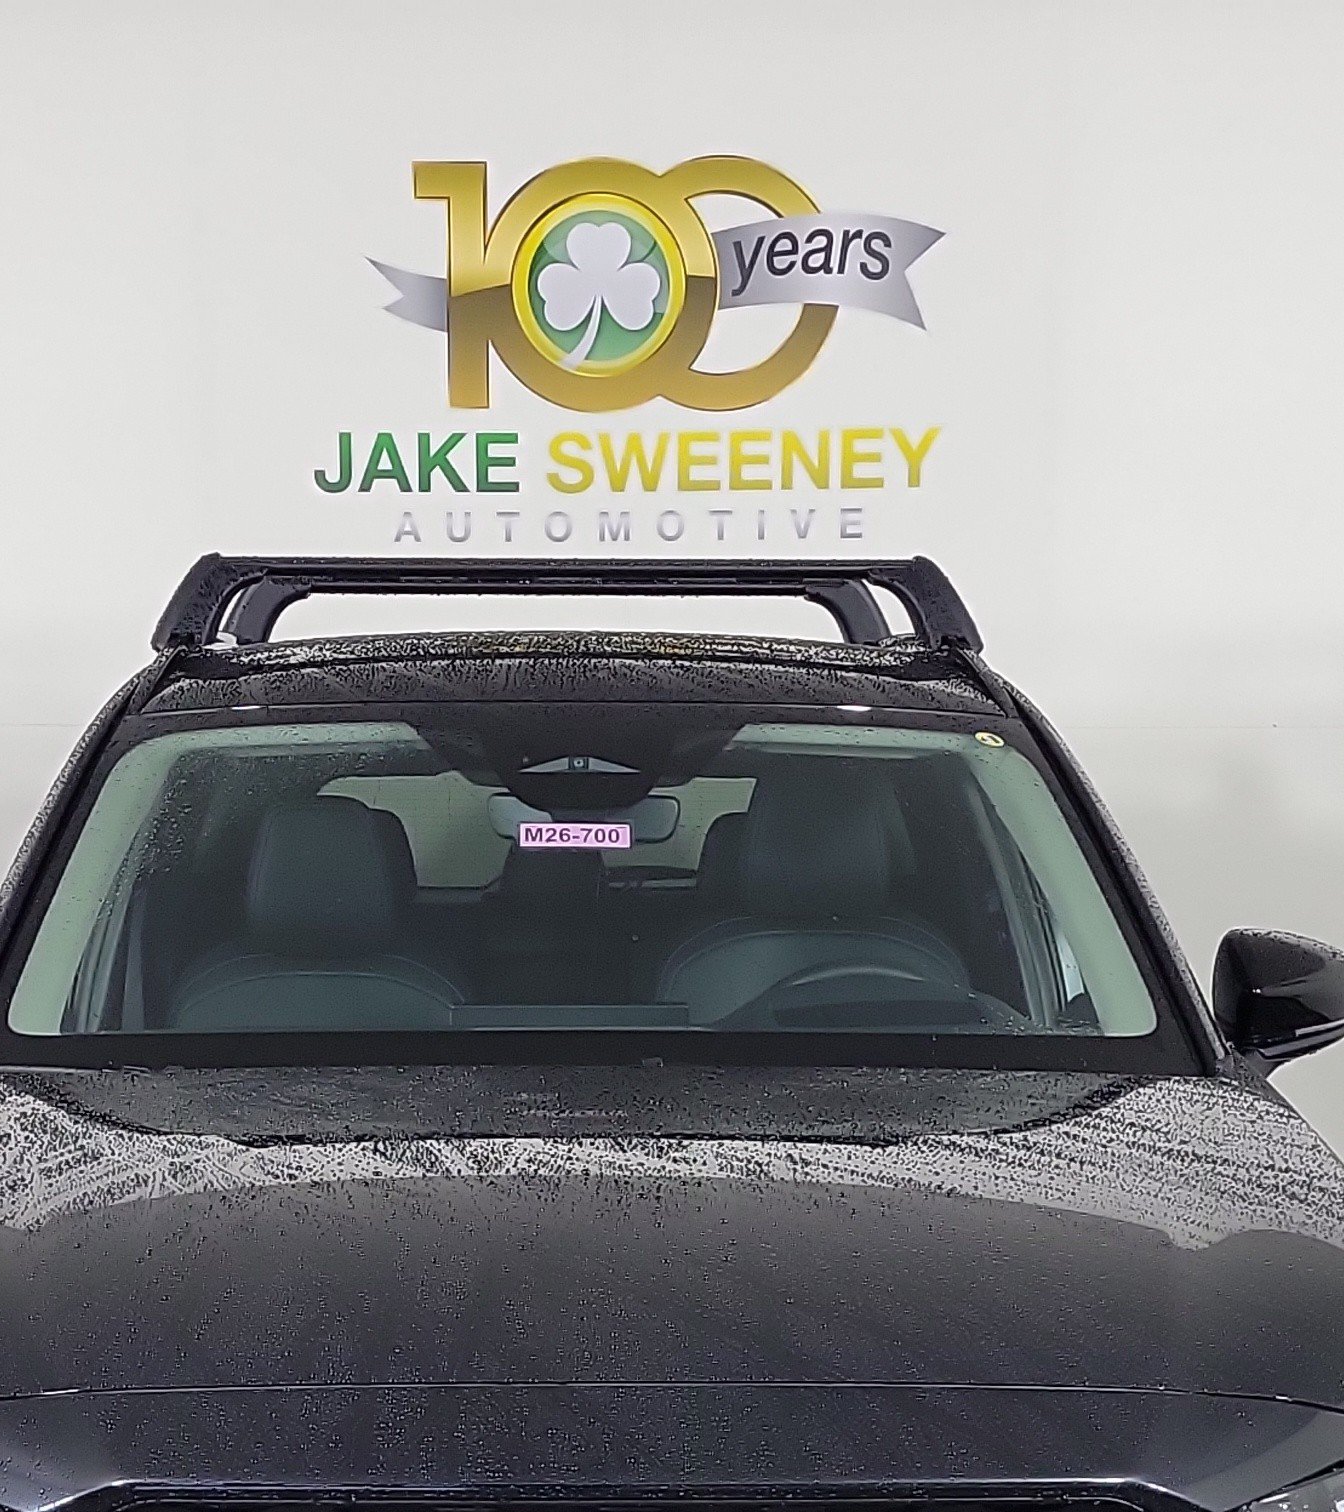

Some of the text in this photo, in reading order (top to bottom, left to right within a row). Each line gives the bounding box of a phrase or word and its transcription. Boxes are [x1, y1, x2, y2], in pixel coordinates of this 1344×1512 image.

[411, 155, 893, 412] 100 years
[313, 426, 942, 495] JAKE SWEENEY
[393, 507, 865, 543] AUTOMOTIVE
[523, 827, 620, 844] M26-700
